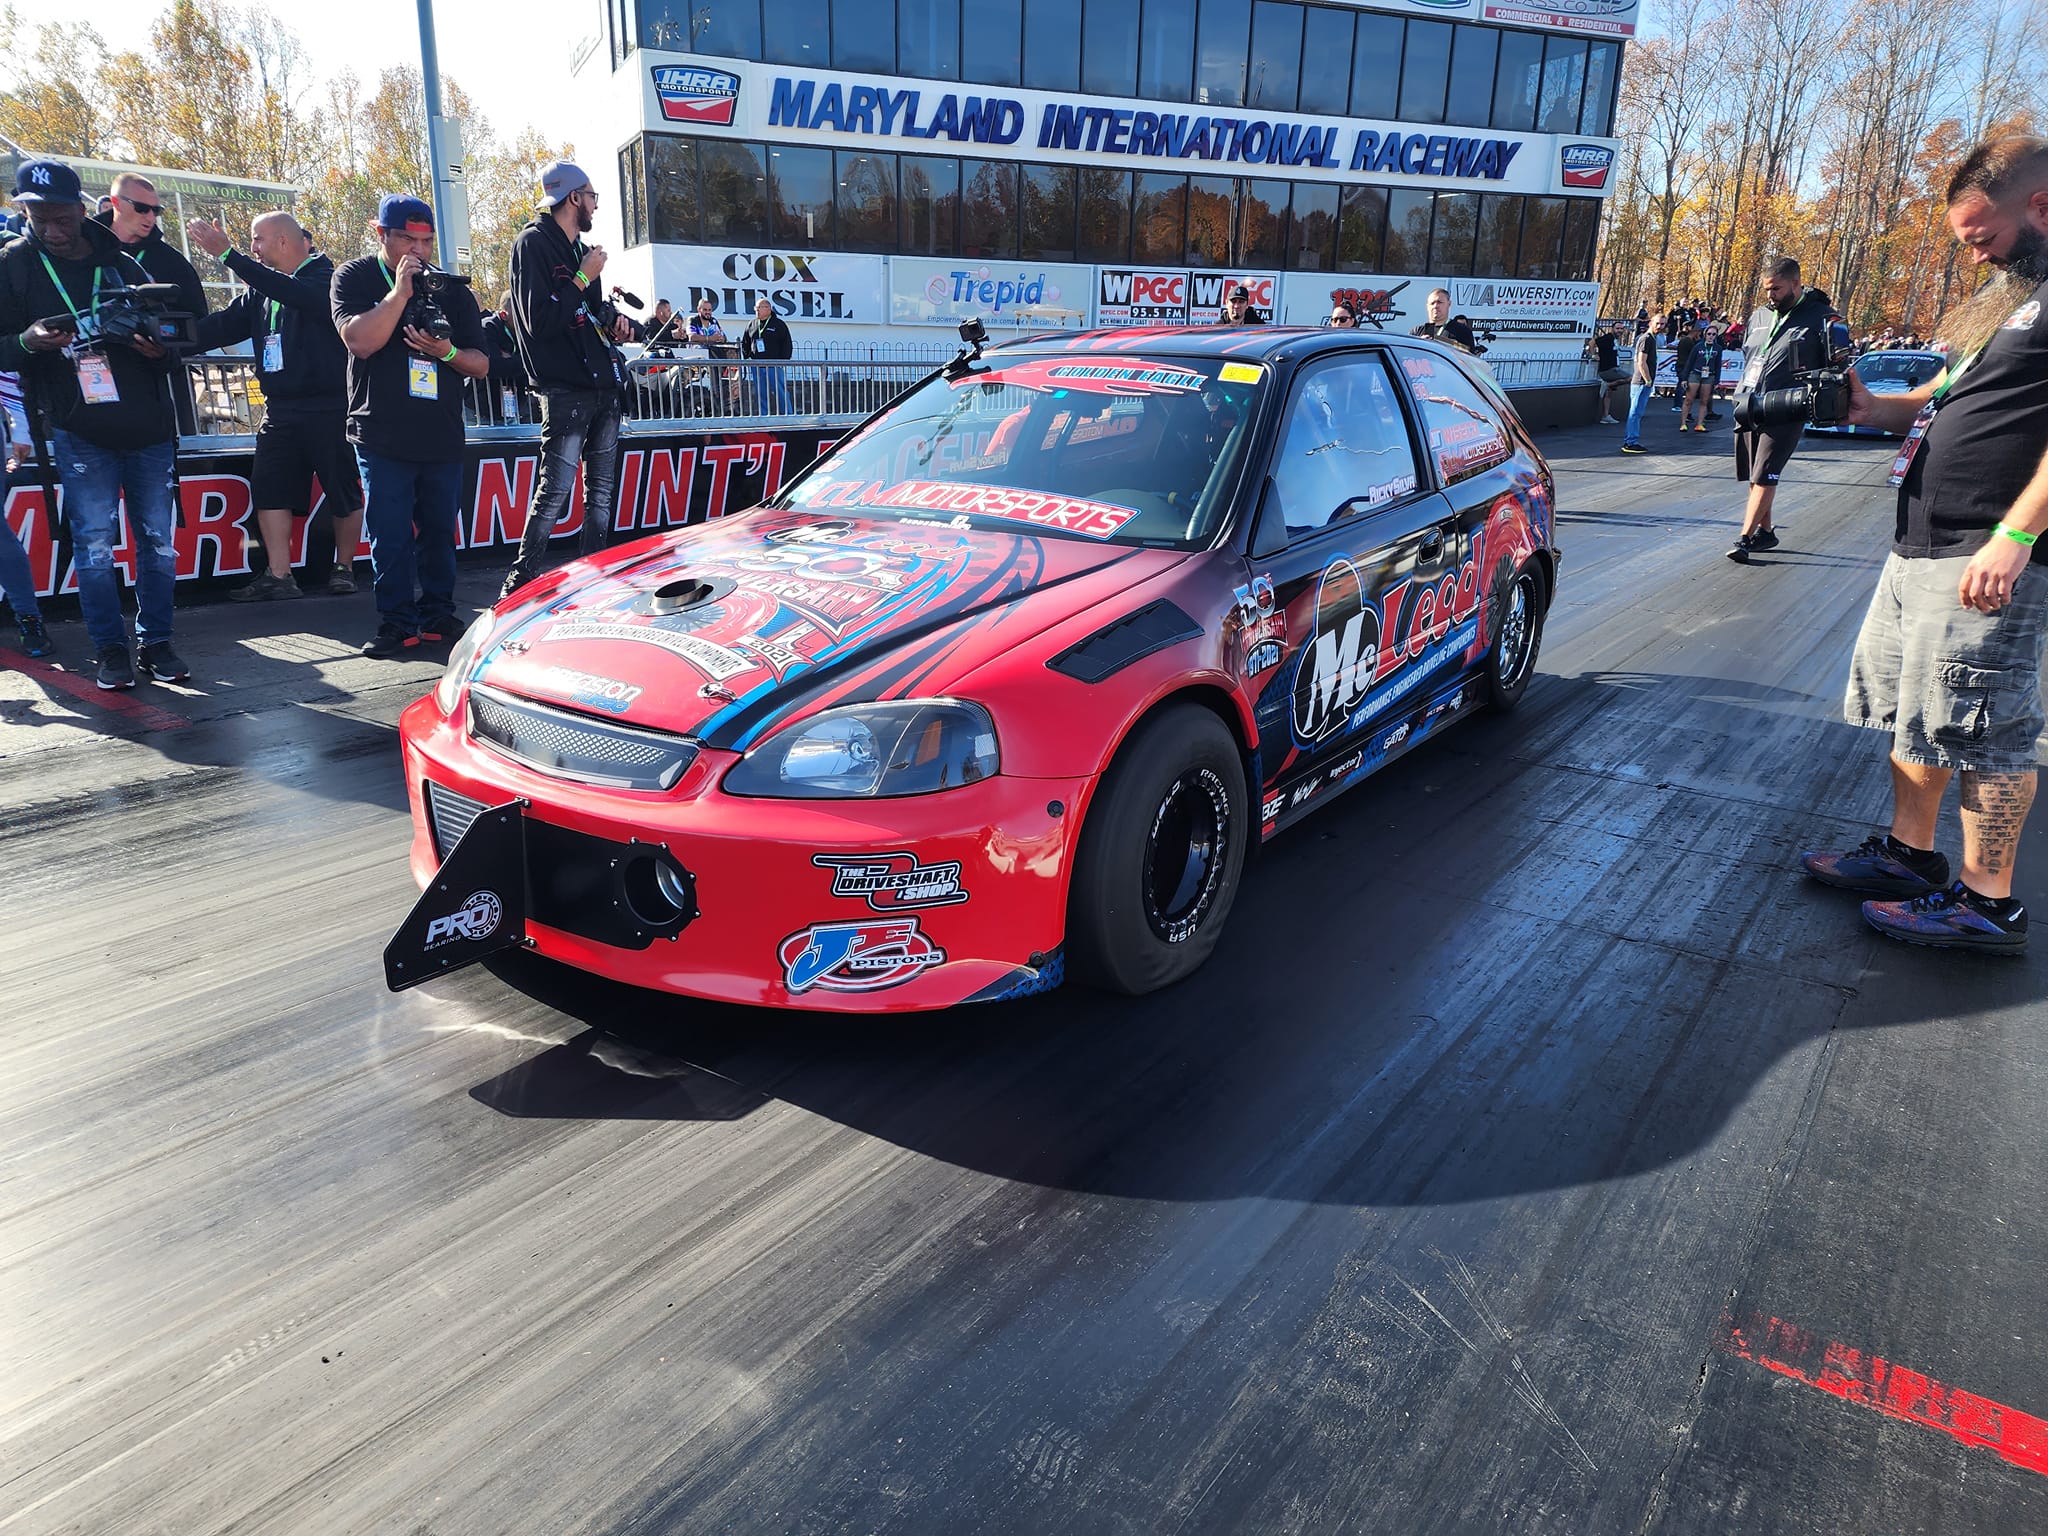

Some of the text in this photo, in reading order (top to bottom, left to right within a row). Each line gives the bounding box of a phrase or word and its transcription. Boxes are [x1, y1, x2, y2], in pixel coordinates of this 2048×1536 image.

[1495, 8, 1622, 33] COMMERCIAL & RESIDENTIAL
[660, 83, 733, 96] MOTORSPORTS
[661, 70, 731, 90] IHRA
[768, 77, 1523, 181] MARYLAND INTERNATIONAL RACEWAY
[1566, 148, 1609, 161] IHRA
[722, 252, 819, 283] COX
[925, 272, 1046, 312] eTrepid
[1102, 274, 1184, 305] WPGC
[1456, 284, 1594, 306] VIA UNIVERSITY.COM
[688, 286, 853, 319] DIESEL
[1132, 307, 1160, 317] 95.5
[1166, 309, 1182, 318] FM
[1500, 307, 1518, 315] Come
[1520, 307, 1535, 315] Build
[1542, 308, 1562, 316] Career
[1564, 308, 1577, 316] With
[1472, 320, 1571, 331] Hiring@VIAUniversity.com
[419, 372, 429, 382] 2
[1055, 366, 1137, 380] GOLDEN
[1138, 368, 1208, 388] EAGLE
[893, 481, 1139, 536] MOTORSPORTS
[1233, 576, 1275, 627] 50
[1301, 530, 1483, 734] McLeod
[748, 639, 792, 666] 2021
[1352, 624, 1477, 730] PERFORMANCE ENGINEERED DRIVELINE COMPONENTS
[1200, 768, 1231, 816] RACING
[839, 868, 954, 890] DRIVESHAFT
[841, 867, 866, 877] THE
[902, 882, 955, 901] SHOP
[426, 903, 491, 944] PRO
[1169, 924, 1197, 943] USA
[423, 934, 461, 952] BEARING
[854, 953, 941, 968] PISTONS
